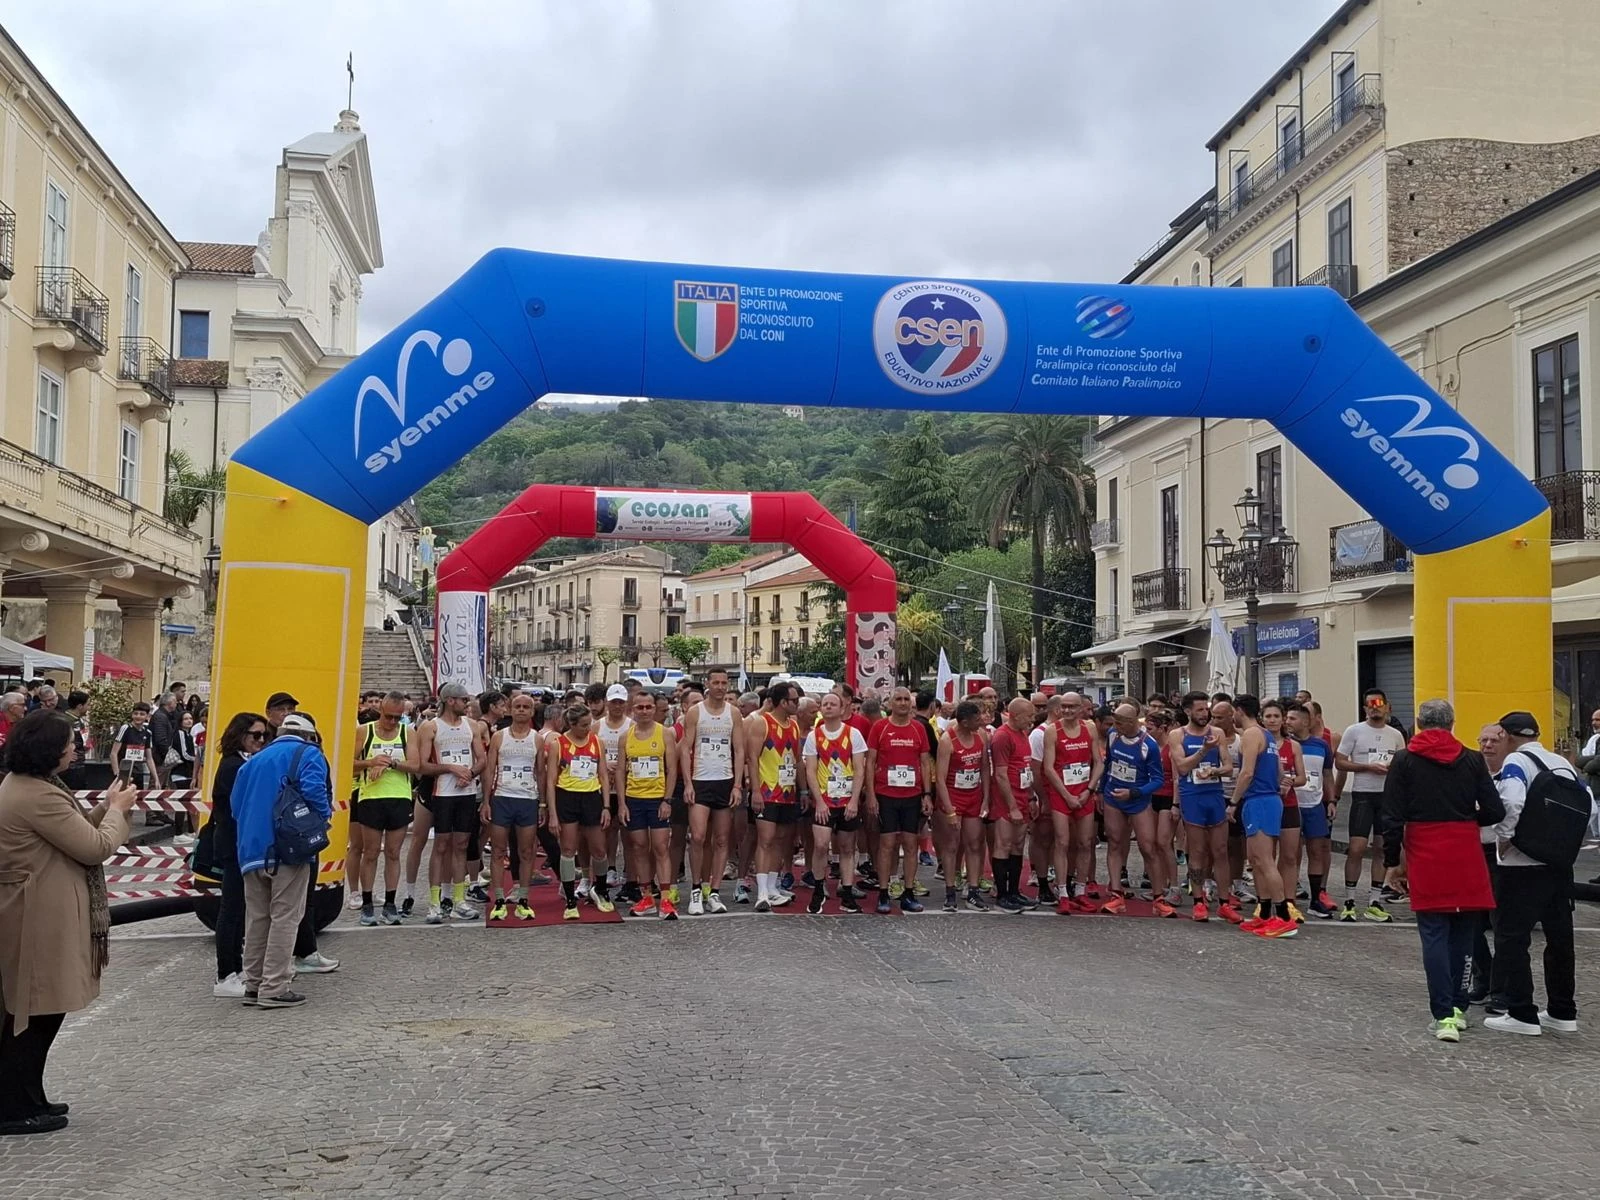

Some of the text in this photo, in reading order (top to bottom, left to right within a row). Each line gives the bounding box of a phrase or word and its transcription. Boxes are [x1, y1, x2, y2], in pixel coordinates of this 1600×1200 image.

[681, 284, 731, 300] ITALIA
[740, 286, 843, 301] ENTE DI PROMOZIONE
[893, 284, 981, 303] CENTRO SPORTIVO
[740, 299, 788, 312] SPORTIVA
[740, 313, 814, 328] RICONOSCIUTO
[740, 329, 784, 341] DAL CONI
[895, 316, 985, 347] csen
[1037, 344, 1183, 361] Ente di Promozione Sportiva
[884, 351, 993, 389] EDUCATIVO NAZIONALE
[1035, 358, 1176, 373] Paralimpica riconosciuto dal
[1031, 373, 1182, 390] Comitato Italiano Paralimpico
[364, 371, 496, 474] syemme
[1340, 407, 1450, 511] syemme
[631, 501, 709, 518] ecosan
[456, 615, 467, 686] SERVIZI
[1379, 753, 1388, 761] 76
[580, 761, 590, 769] 27
[1072, 768, 1083, 776] 46
[1118, 766, 1127, 774] 21
[512, 771, 522, 779] 34
